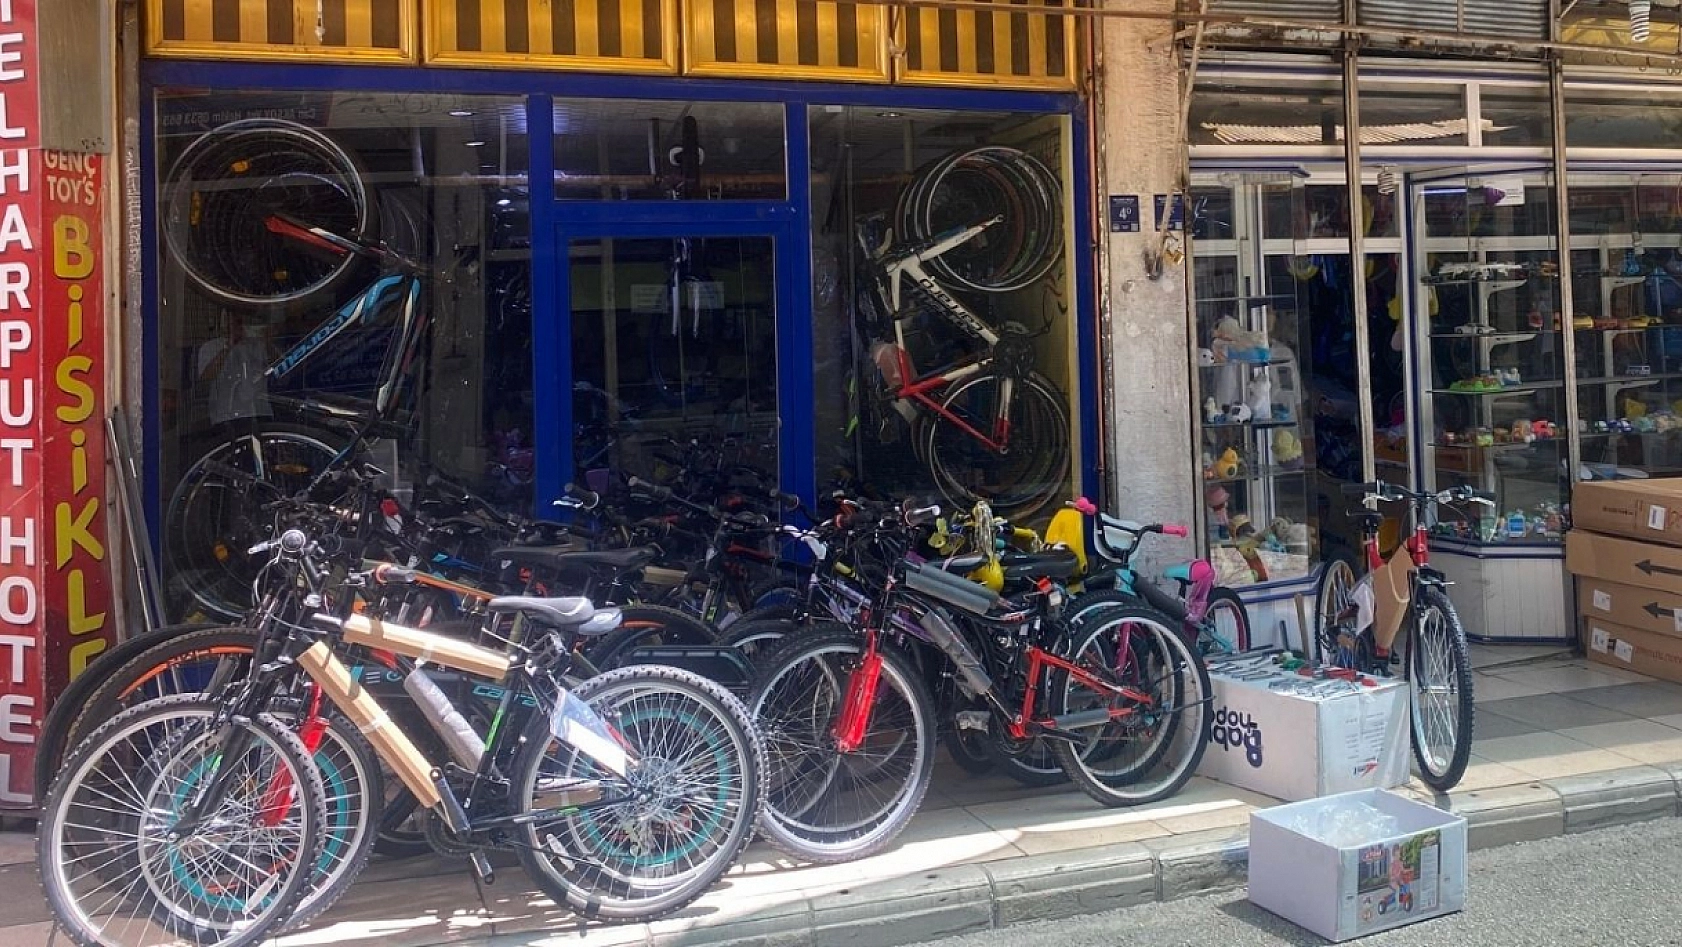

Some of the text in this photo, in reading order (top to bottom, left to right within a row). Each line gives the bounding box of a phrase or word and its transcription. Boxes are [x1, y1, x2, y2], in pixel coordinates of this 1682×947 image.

[44, 149, 97, 178] GENÇ
[46, 174, 95, 206] TOY'S
[0, 149, 33, 487] HARPUT
[0, 515, 36, 805] HOTEL
[1211, 706, 1253, 734] hop
[1209, 725, 1262, 767] Bab
